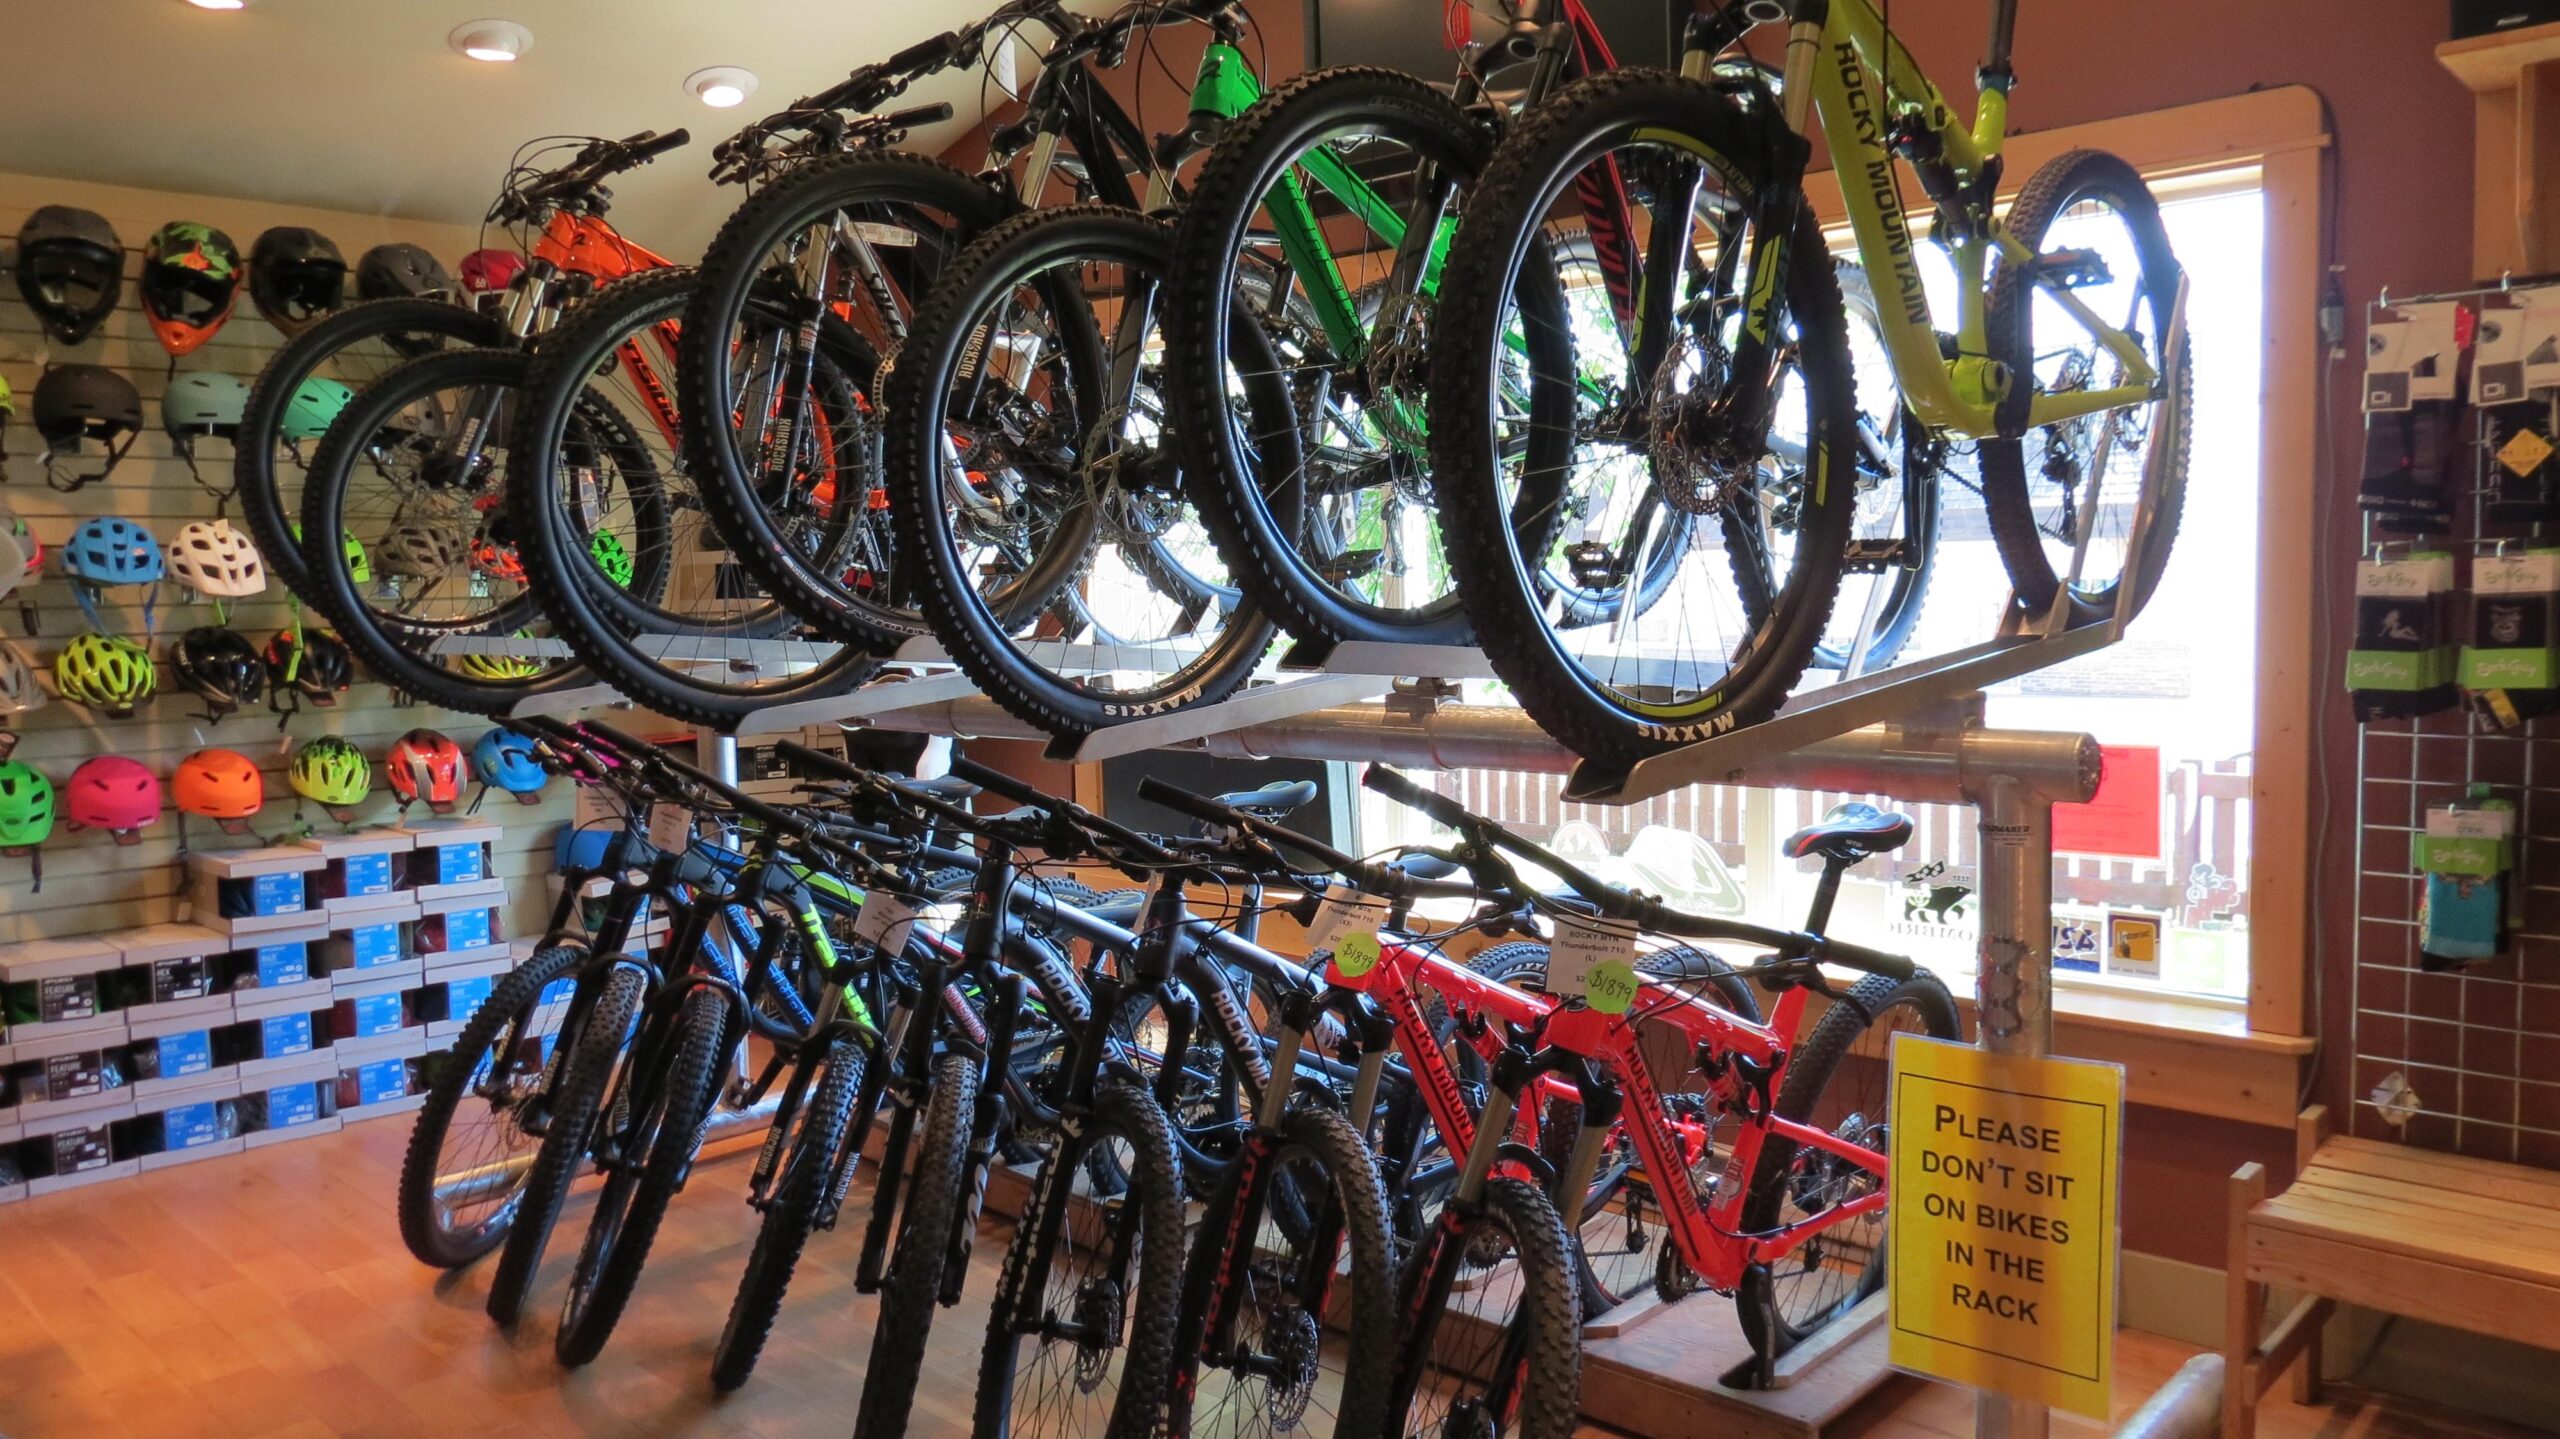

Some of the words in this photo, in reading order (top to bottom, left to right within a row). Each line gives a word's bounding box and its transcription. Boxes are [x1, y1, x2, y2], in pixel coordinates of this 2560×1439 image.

[1834, 40, 1881, 148] ROCKY
[1866, 159, 1929, 325] MOUNTAIN
[771, 418, 792, 472] ROCKSHOX
[1105, 684, 1202, 717] MAXXIS
[1637, 711, 1735, 742] MAXXIS
[1342, 942, 1374, 969] $1899
[1589, 969, 1633, 1004] $1899
[1434, 1067, 1475, 1140] MOUNT
[1935, 1104, 2060, 1153] PLEASE
[1922, 1150, 2015, 1189] DON'T
[2025, 1170, 2074, 1200] SIT
[1923, 1193, 1965, 1222] ON
[1976, 1203, 2070, 1244] BIKES
[1946, 1239, 1974, 1267] IN
[1984, 1248, 2045, 1284] THE
[1952, 1282, 2039, 1325] RACK
